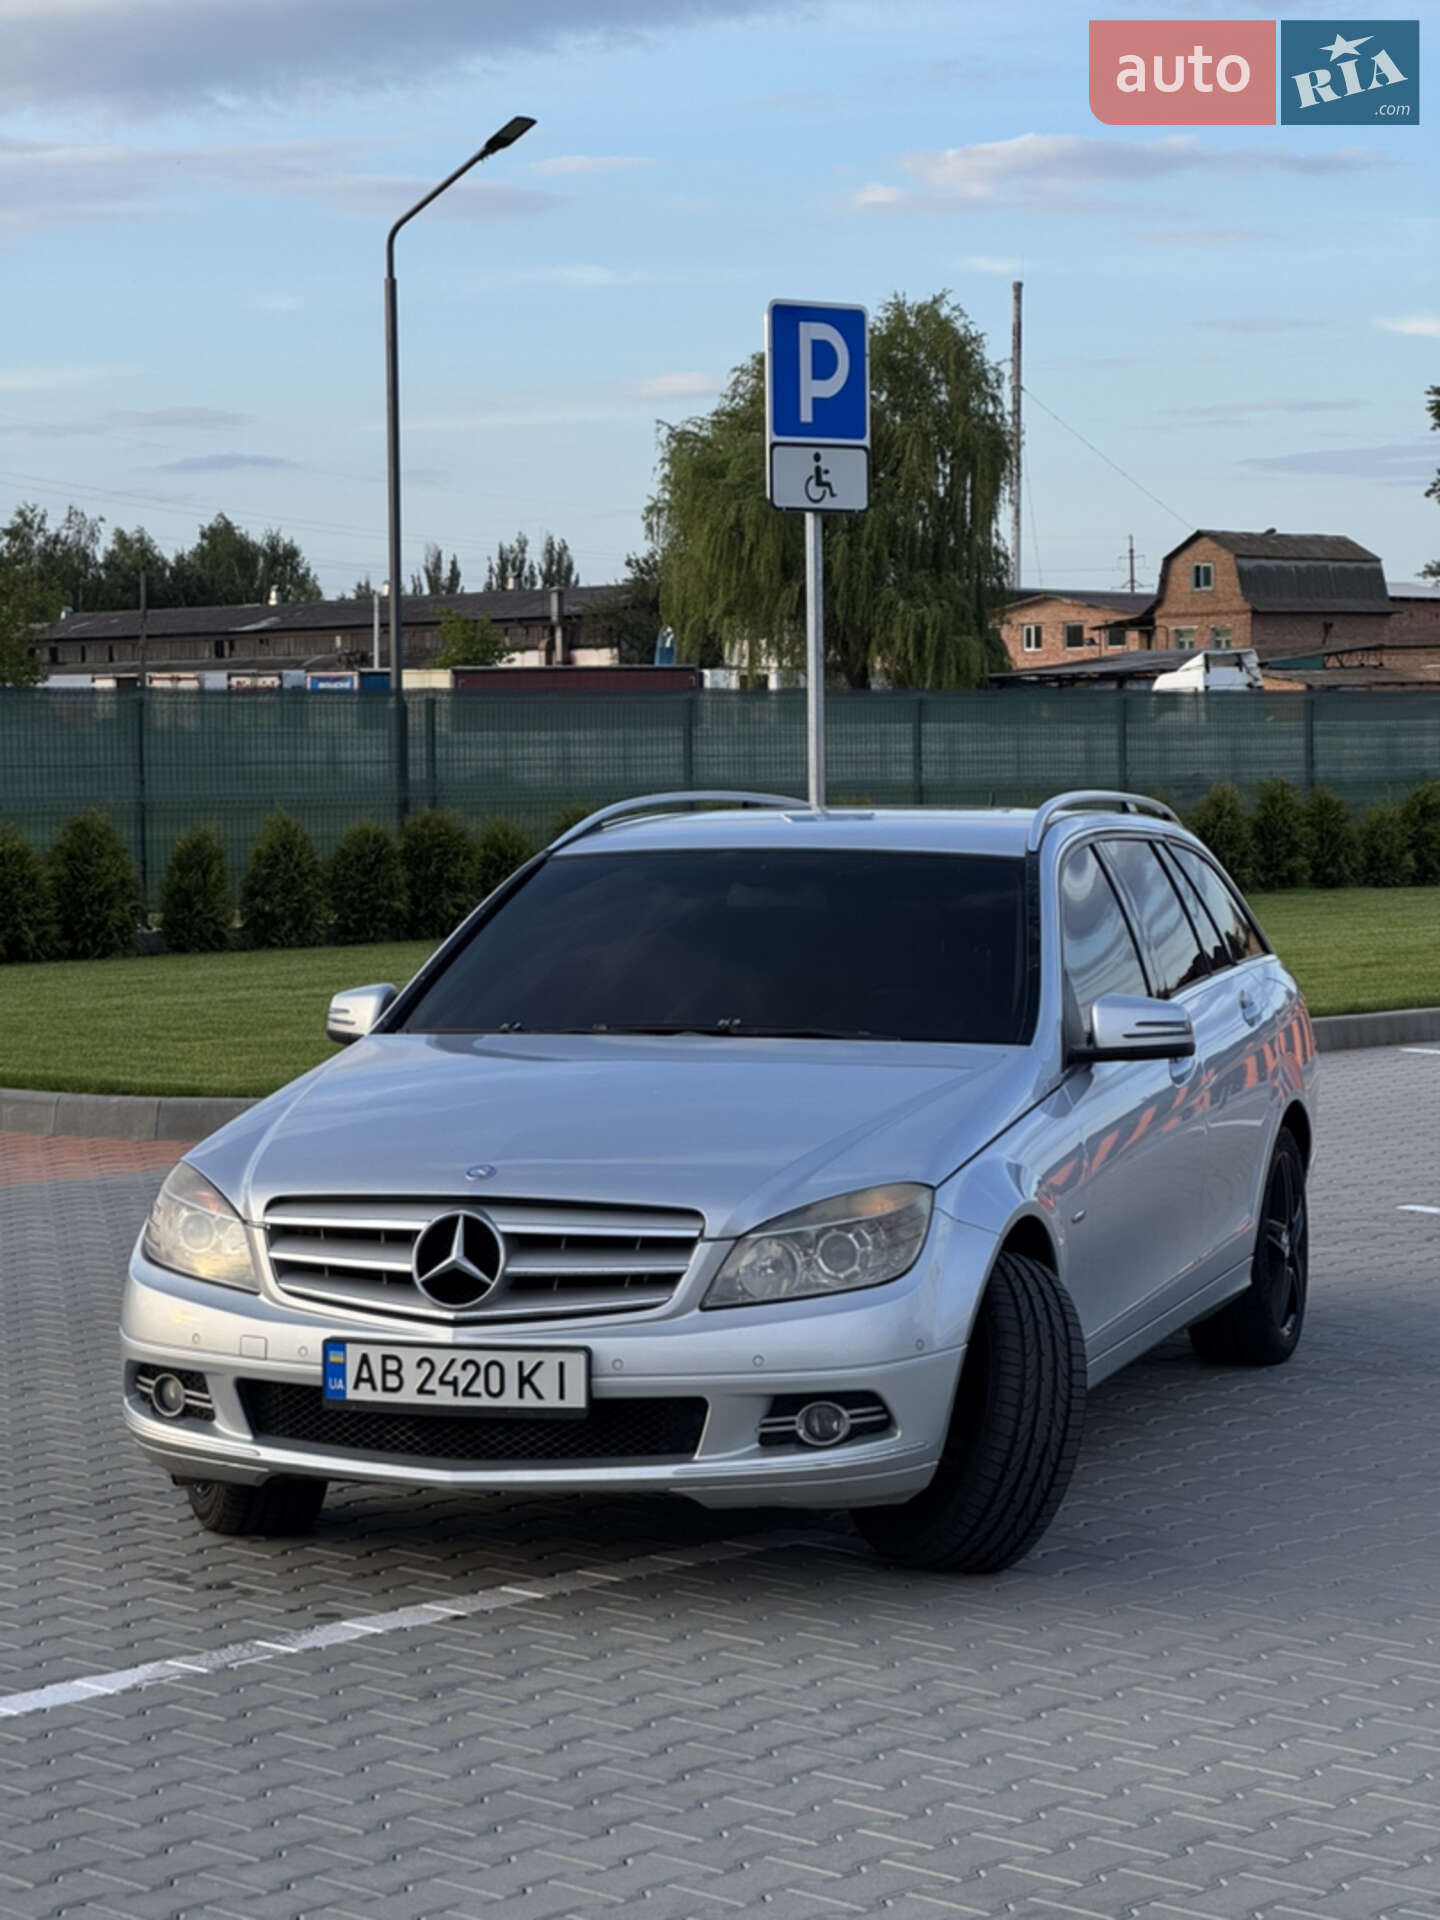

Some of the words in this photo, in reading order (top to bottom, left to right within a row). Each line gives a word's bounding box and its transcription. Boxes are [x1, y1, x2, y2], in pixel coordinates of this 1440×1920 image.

[799, 321, 850, 423] P
[328, 1376, 345, 1390] UA
[353, 1353, 404, 1393] AB
[416, 1357, 505, 1398] 2420
[517, 1360, 565, 1401] KI
